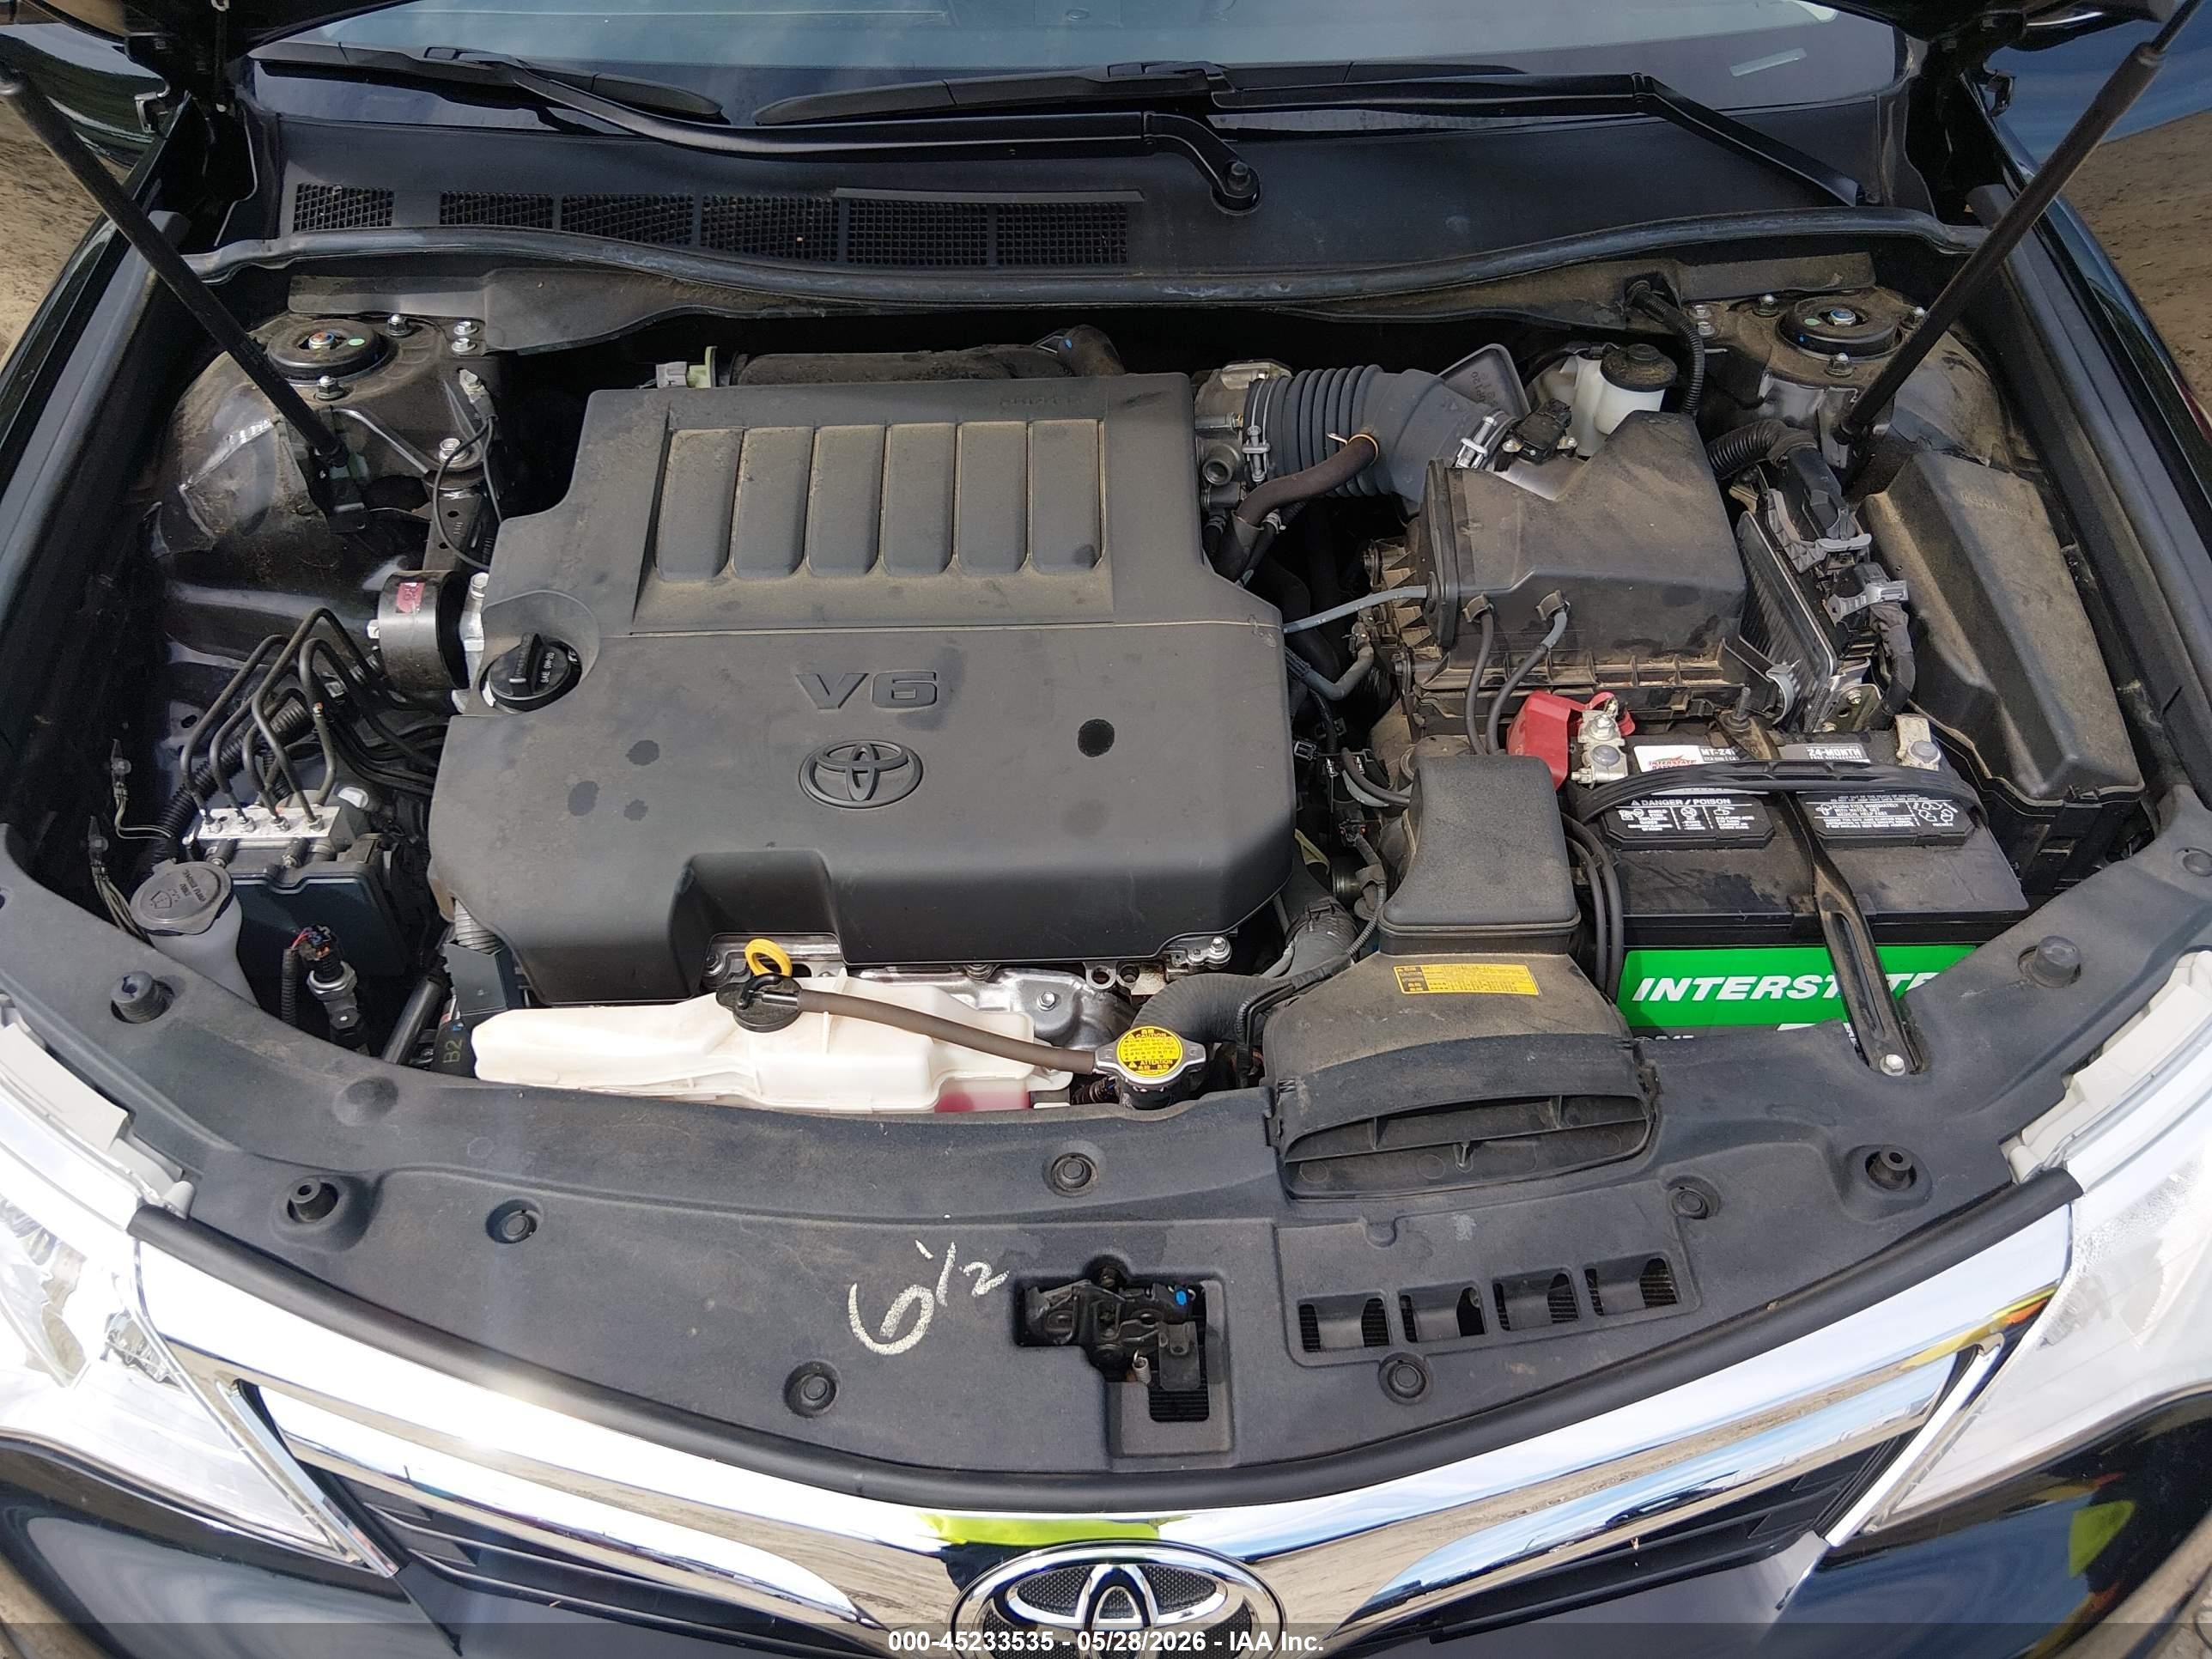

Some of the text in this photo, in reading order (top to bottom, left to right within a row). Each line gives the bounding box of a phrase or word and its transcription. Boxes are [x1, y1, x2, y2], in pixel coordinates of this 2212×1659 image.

[540, 671, 550, 684] SAE
[796, 671, 938, 709] V6
[1631, 972, 1938, 1003] INTERSTTE
[442, 1039, 462, 1063] B2
[848, 1282, 935, 1356] 6
